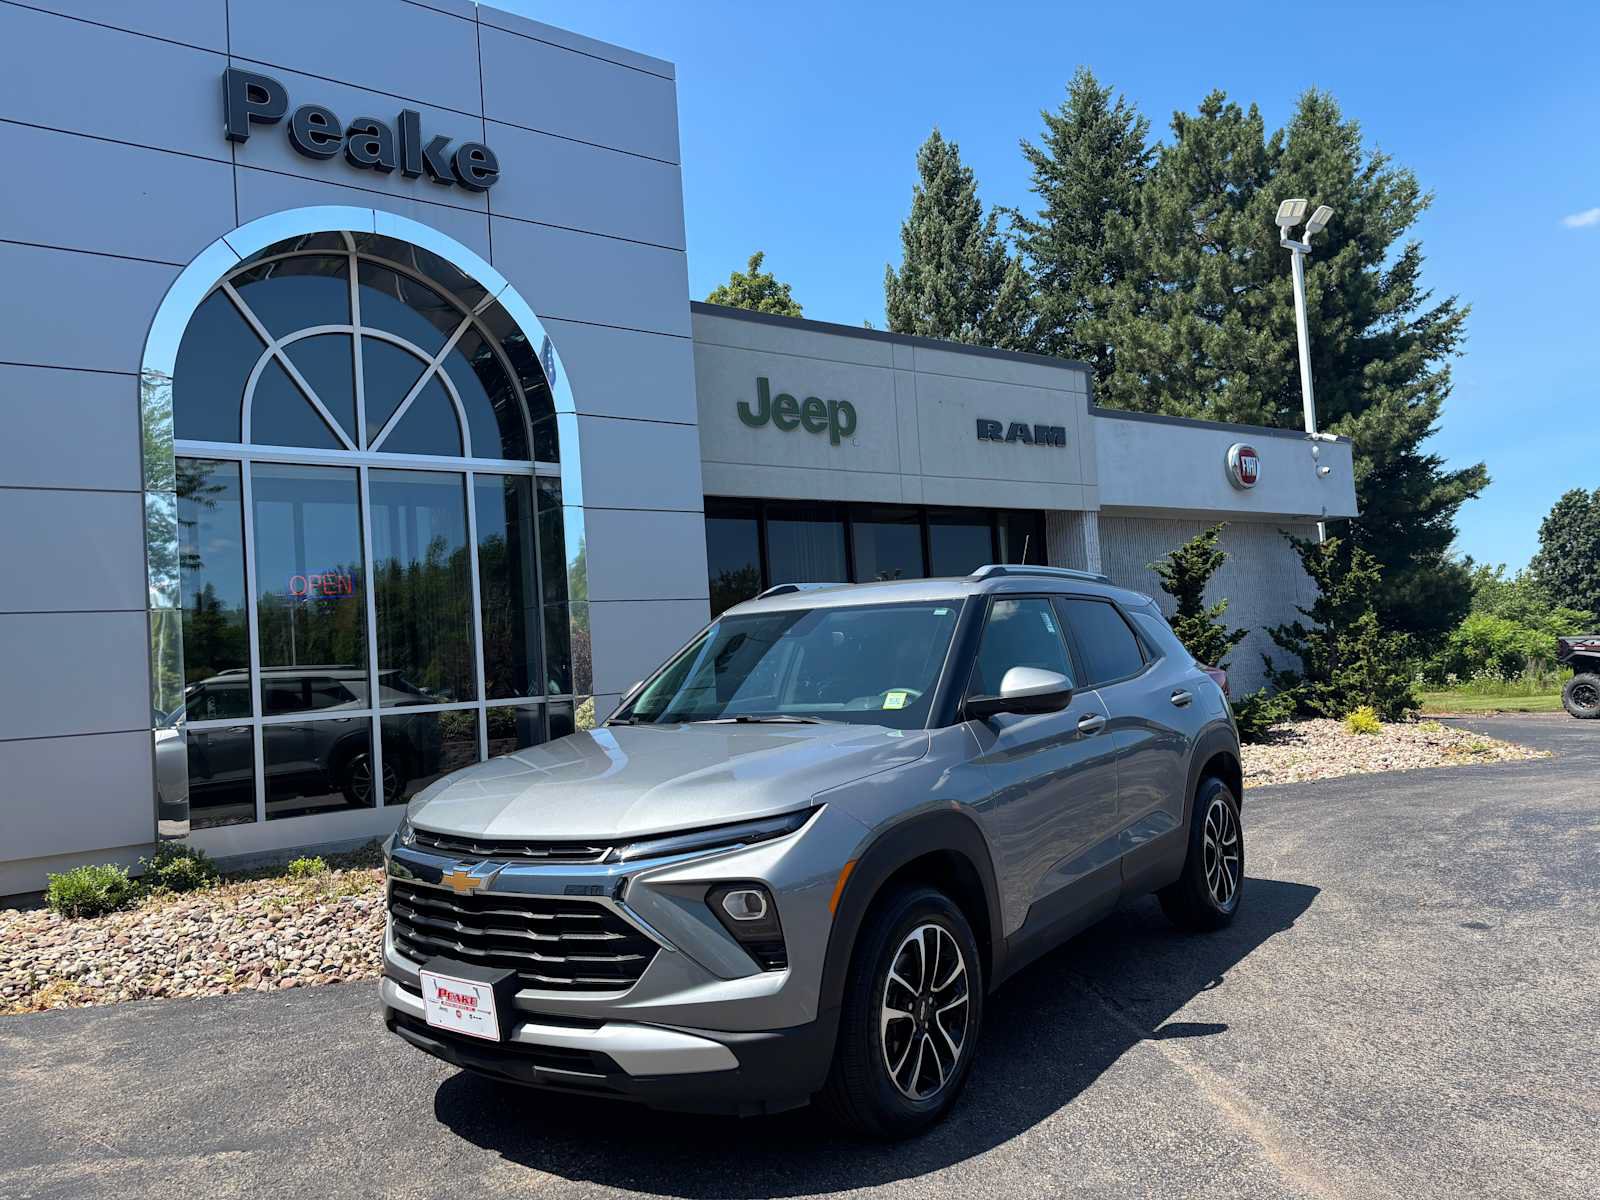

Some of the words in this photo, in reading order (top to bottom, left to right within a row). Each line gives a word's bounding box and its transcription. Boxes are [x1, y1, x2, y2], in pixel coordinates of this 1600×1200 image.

[224, 67, 499, 192] Peake
[737, 377, 857, 446] Jeep
[976, 418, 1067, 448] RAM
[1240, 455, 1258, 477] FIAT
[290, 574, 353, 596] OPEN
